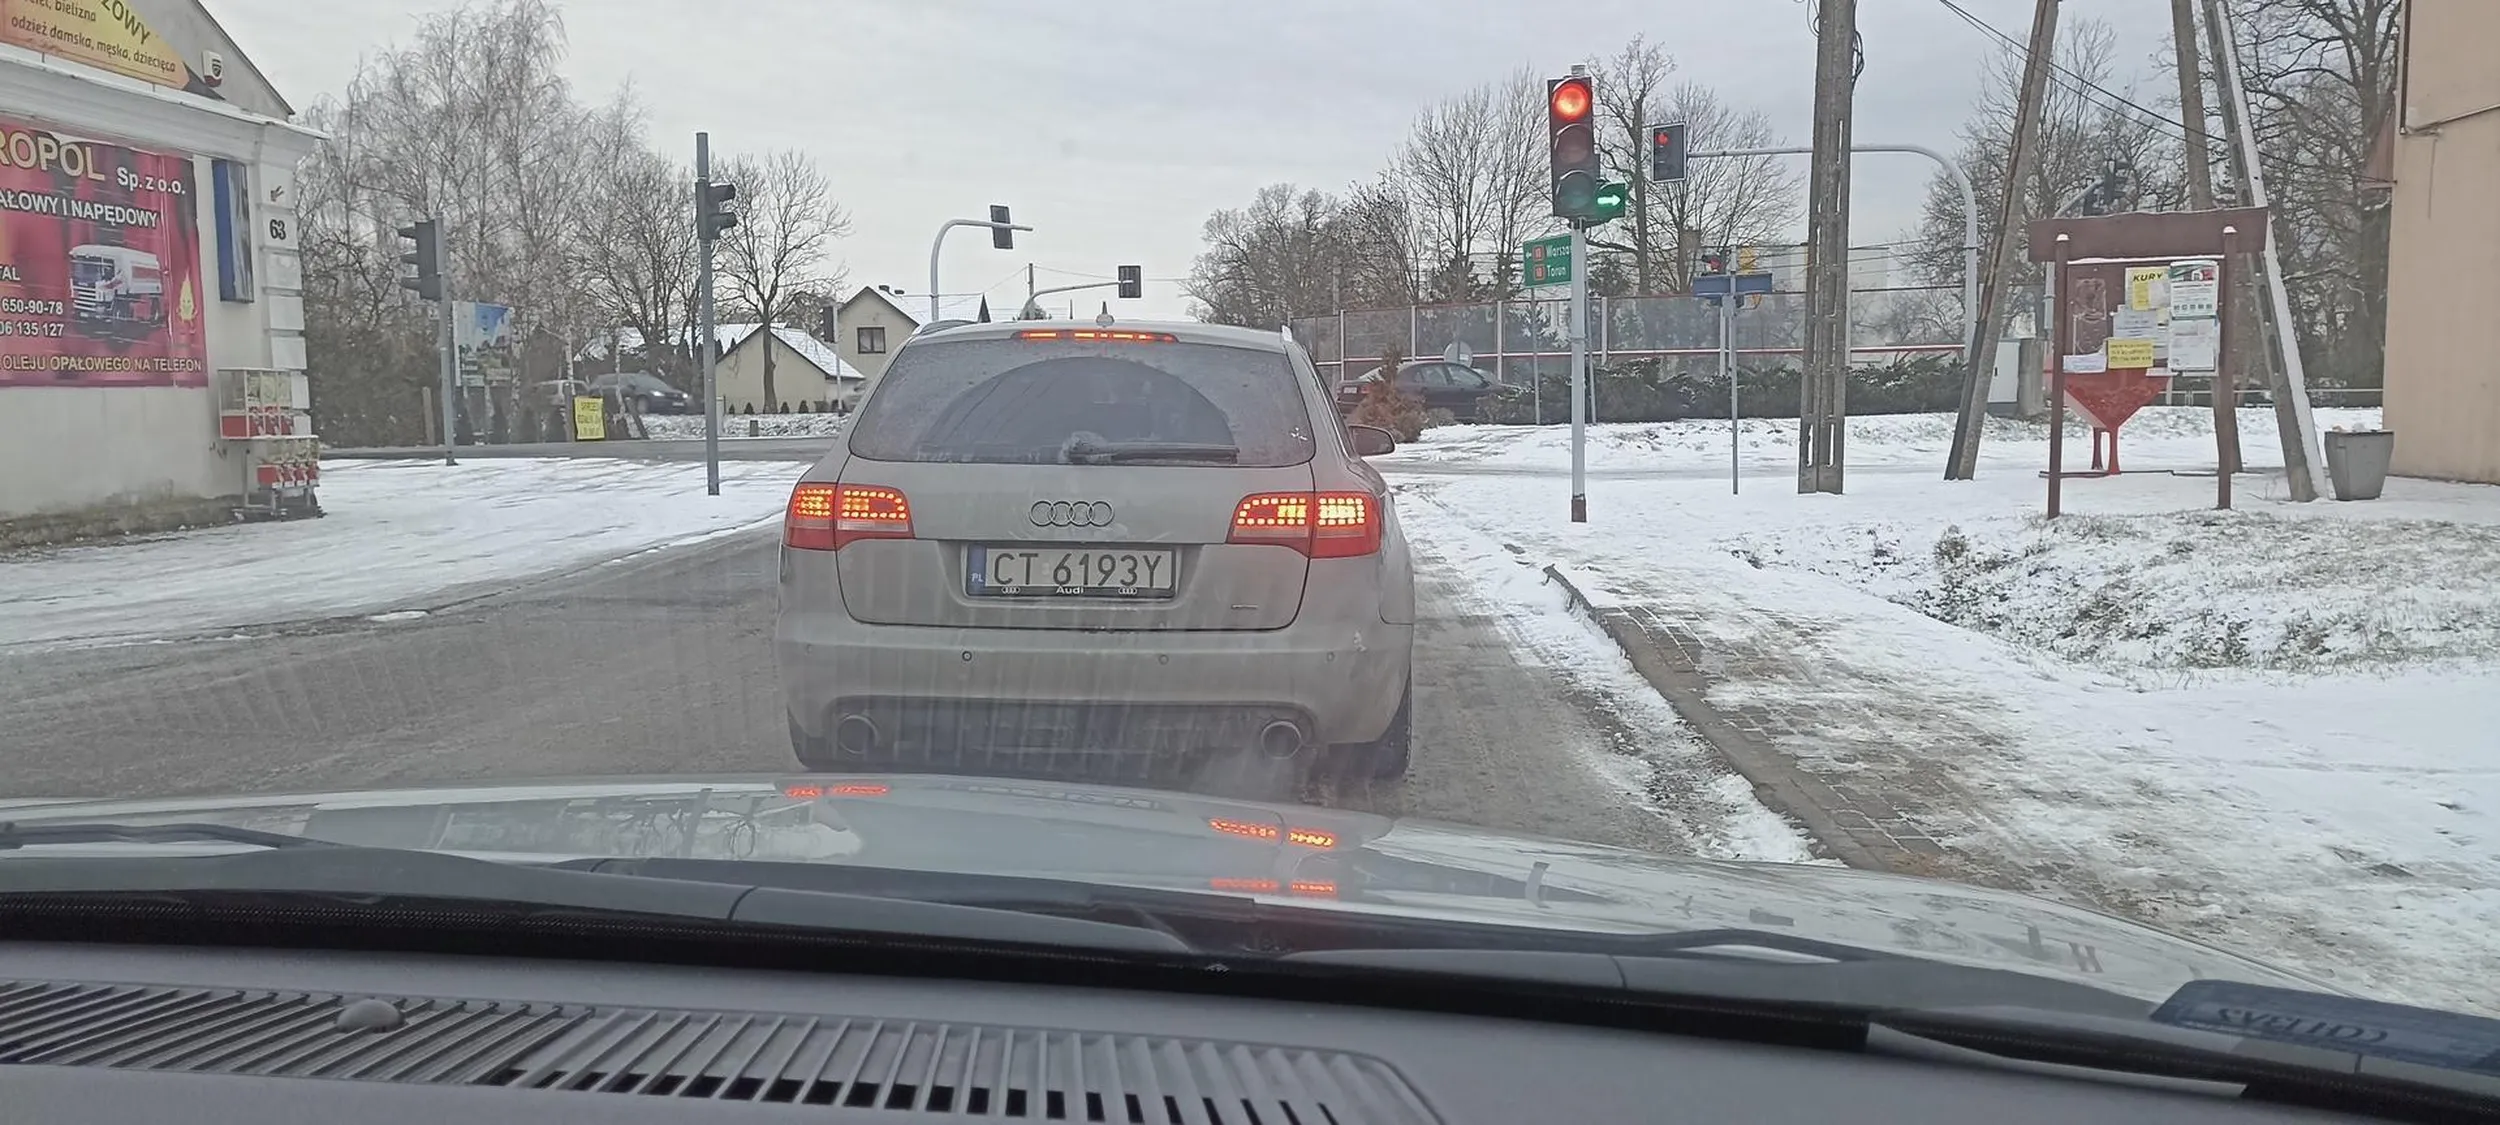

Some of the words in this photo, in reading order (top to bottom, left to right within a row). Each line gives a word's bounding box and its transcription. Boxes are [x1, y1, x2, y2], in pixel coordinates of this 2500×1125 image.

[11, 16, 47, 36] odzież
[50, 25, 94, 50] damska,
[97, 41, 131, 62] męska,
[117, 166, 143, 190] Sp.
[146, 177, 154, 190] z
[158, 179, 186, 195] o.o.
[63, 198, 68, 216] I
[71, 200, 159, 228] NAPĘDOWY
[270, 219, 286, 240] 63
[0, 266, 20, 281] AL
[2133, 272, 2163, 281] KURY
[2, 299, 63, 315] 650-90-78
[16, 322, 39, 336] 135
[42, 323, 64, 337] 127
[3, 355, 46, 370] OLEJU
[50, 356, 131, 371] OPAŁOWEGO
[134, 358, 150, 371] NA
[154, 358, 201, 372] TELEFON
[971, 573, 983, 582] PL
[994, 553, 1039, 585] CT
[1053, 553, 1162, 588] 6193Y
[1056, 586, 1084, 594] Audi
